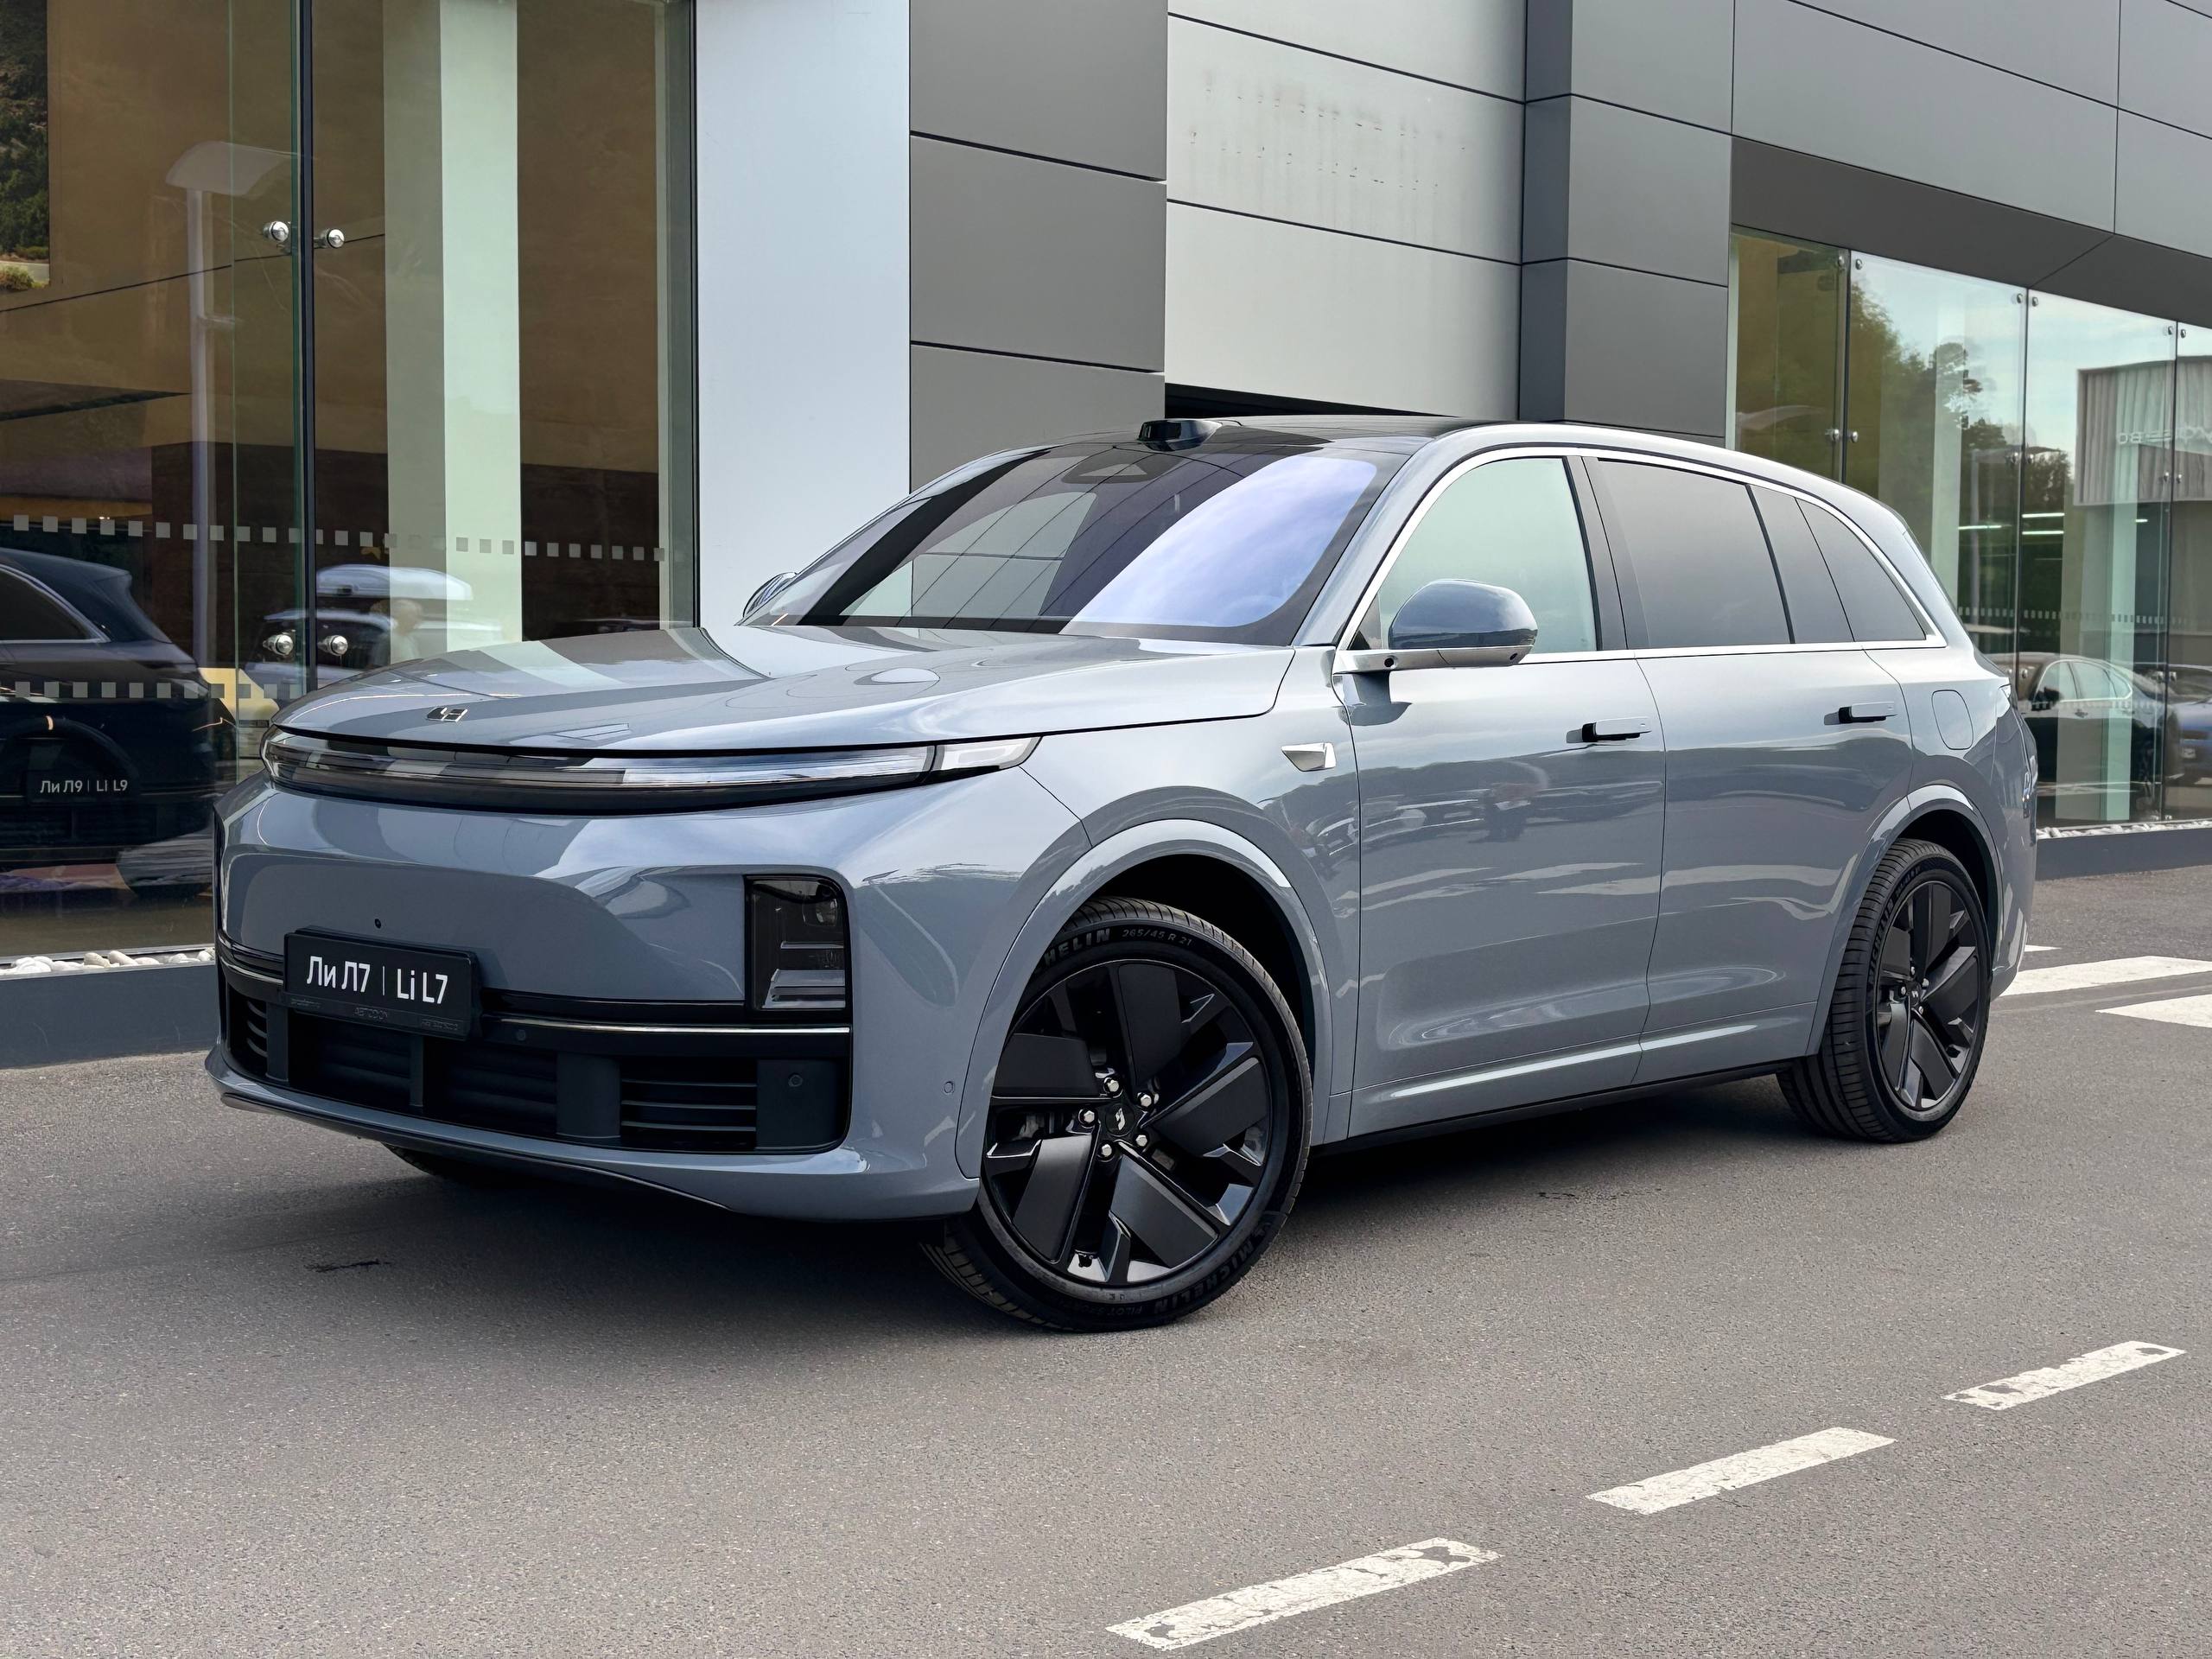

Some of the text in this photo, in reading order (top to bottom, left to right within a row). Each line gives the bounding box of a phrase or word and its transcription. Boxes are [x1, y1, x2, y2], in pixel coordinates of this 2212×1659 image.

[40, 779, 83, 793] Ли Л9
[113, 779, 128, 791] L9
[1043, 927, 1110, 967] HELIN
[306, 955, 371, 993] Ли Л7
[397, 968, 448, 1004] Li L7
